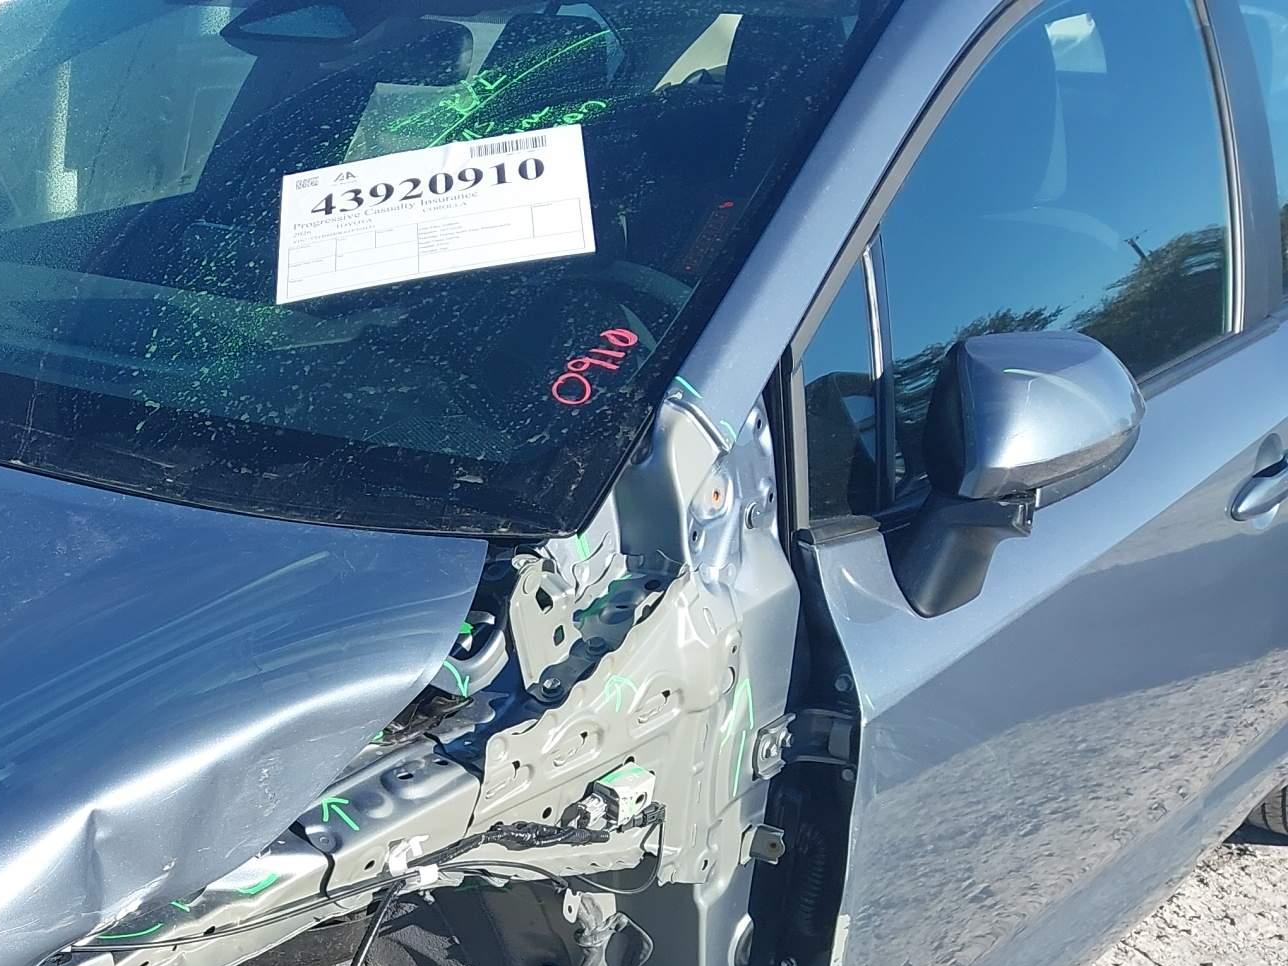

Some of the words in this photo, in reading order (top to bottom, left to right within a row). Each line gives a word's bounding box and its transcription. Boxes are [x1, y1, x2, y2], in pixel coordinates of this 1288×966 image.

[293, 211, 361, 231] Progressive
[364, 201, 416, 216] Casualty
[420, 192, 479, 207] Insurance
[311, 157, 545, 216] 43920910
[552, 328, 638, 404] 0910
